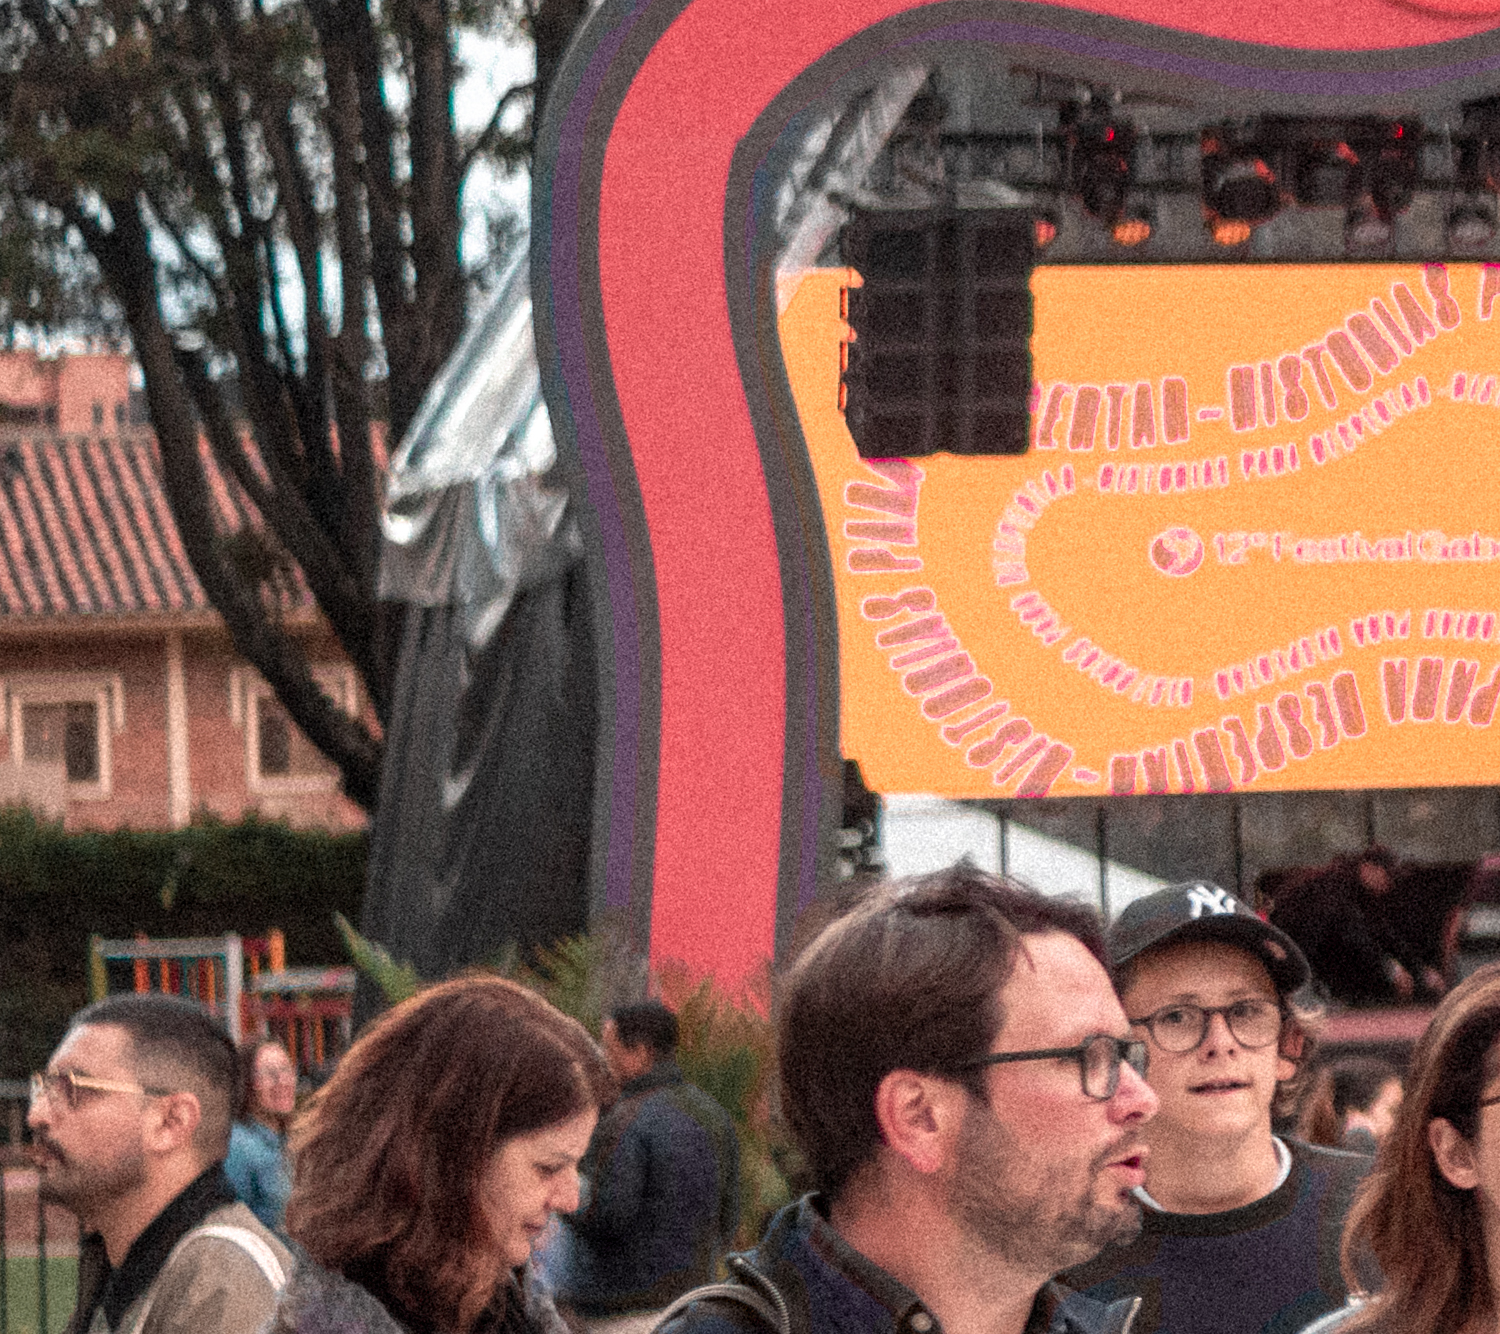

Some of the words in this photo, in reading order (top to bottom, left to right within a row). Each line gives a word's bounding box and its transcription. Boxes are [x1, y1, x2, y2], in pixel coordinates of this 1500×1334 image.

[1030, 378, 1188, 449] ERTAR
[1229, 263, 1460, 430] HISTORIAS
[863, 588, 1073, 798] HISTORIAS
[1110, 671, 1367, 795] DESPERTAR
